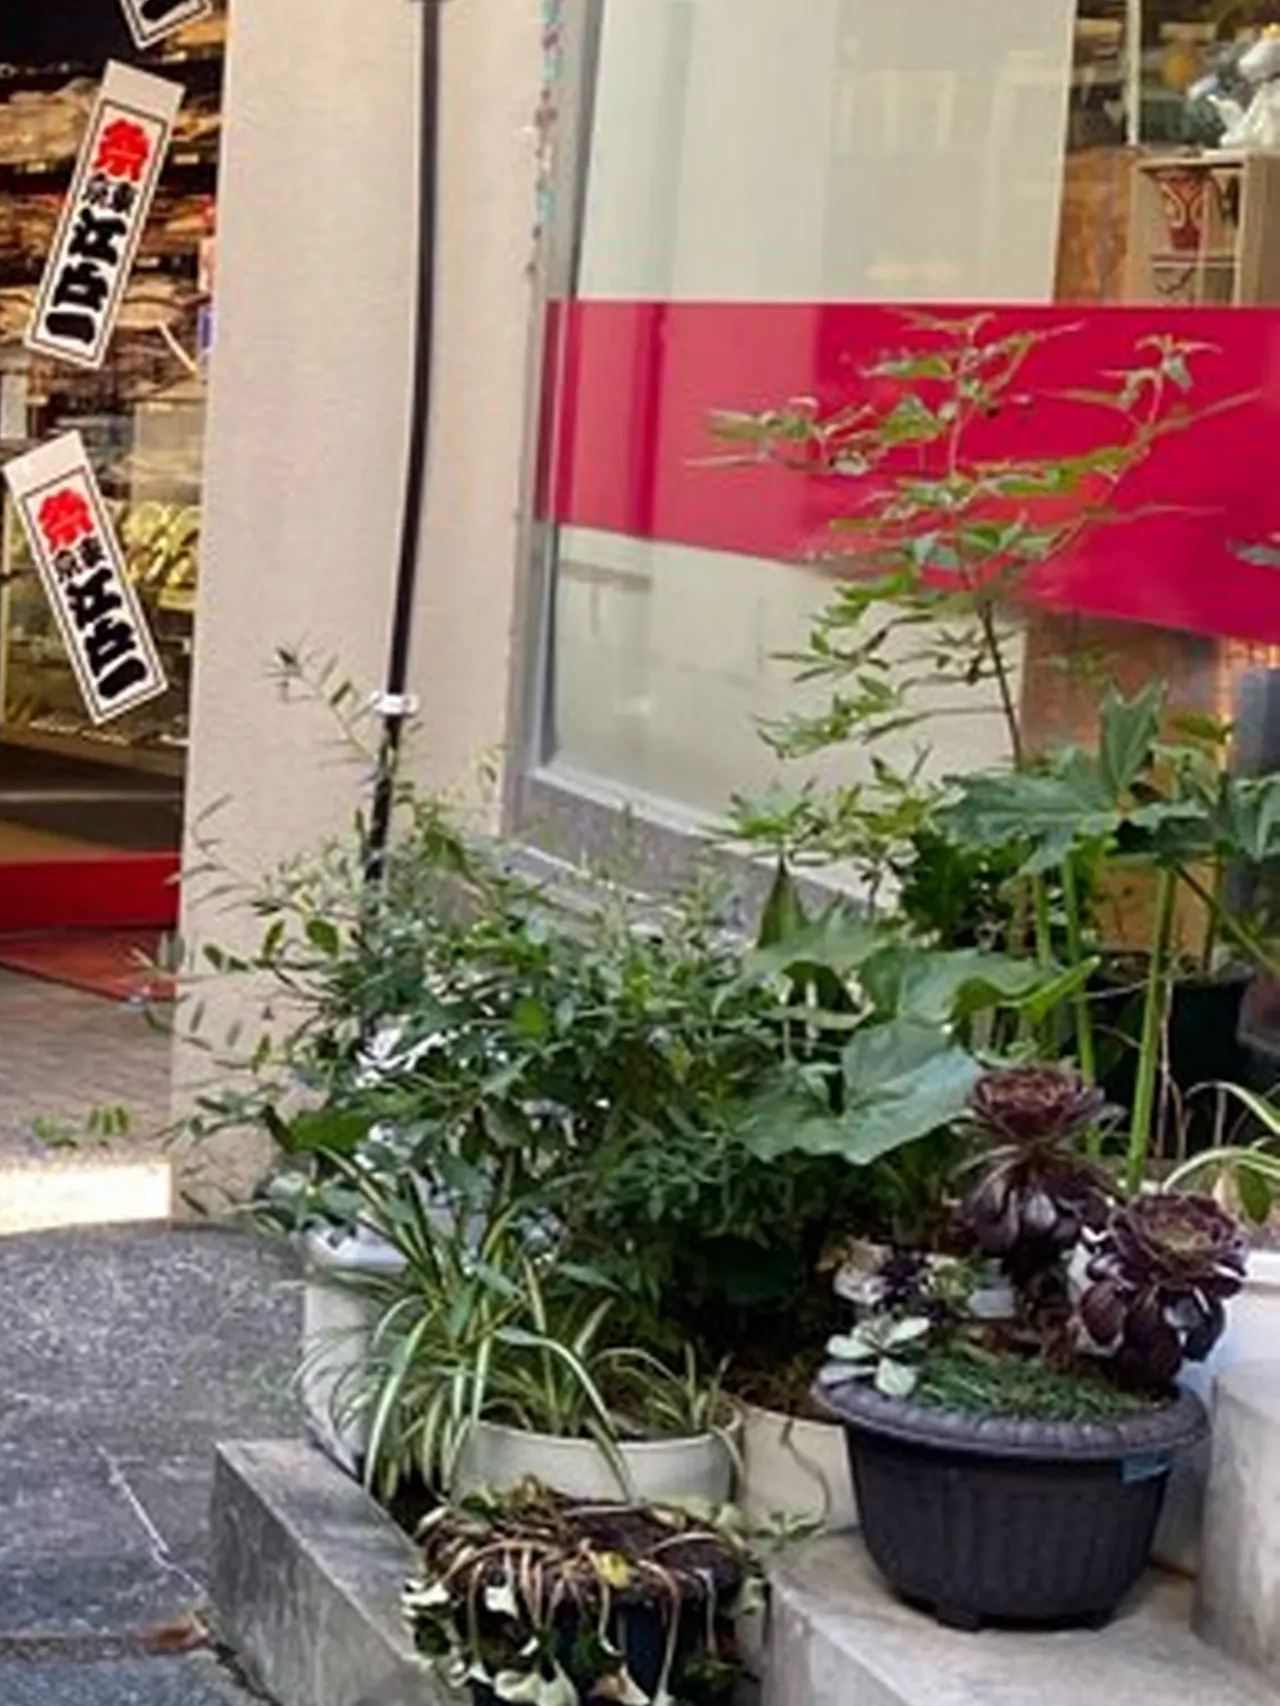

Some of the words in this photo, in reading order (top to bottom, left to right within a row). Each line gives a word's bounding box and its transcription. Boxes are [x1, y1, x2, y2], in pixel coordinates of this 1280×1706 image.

[45, 207, 128, 345] 江戸一
[66, 567, 148, 700] 江戸一
